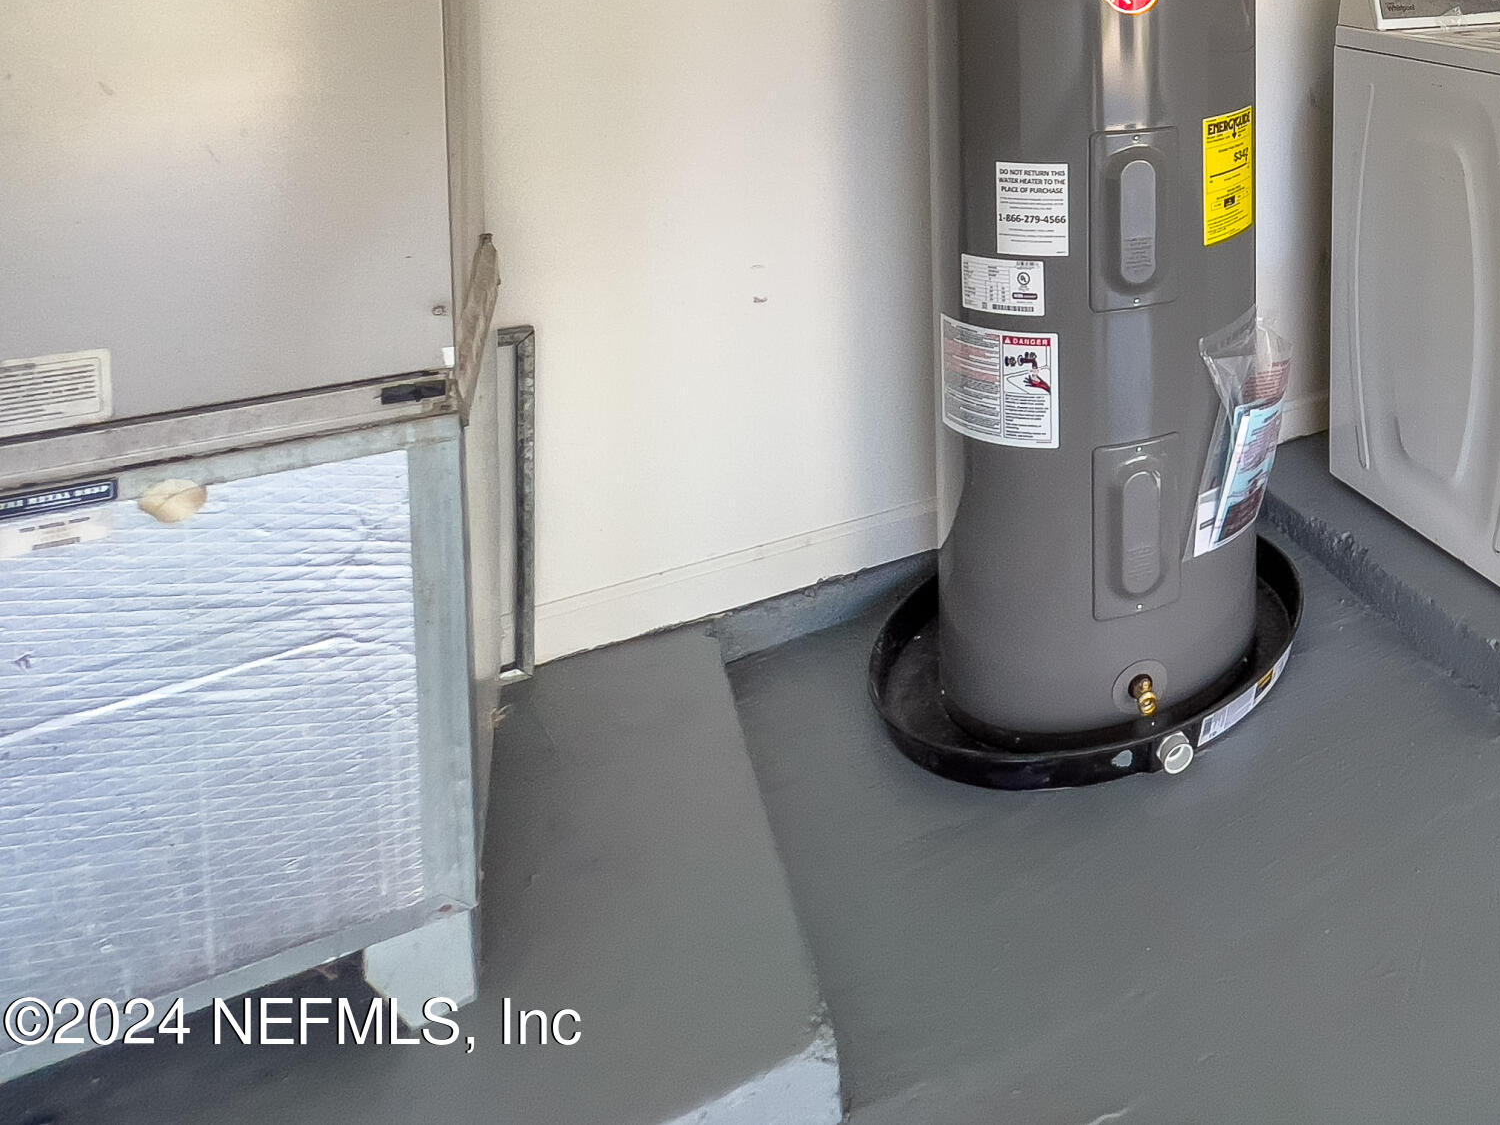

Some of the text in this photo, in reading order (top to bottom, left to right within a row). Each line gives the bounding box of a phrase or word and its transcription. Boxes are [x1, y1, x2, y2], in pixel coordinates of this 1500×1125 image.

[1386, 4, 1416, 12] Whirlpool
[1024, 169, 1049, 177] RETURN
[1001, 185, 1018, 193] PLACE
[998, 213, 1067, 224] 1-866-279-4566
[1012, 336, 1049, 346] DANGER
